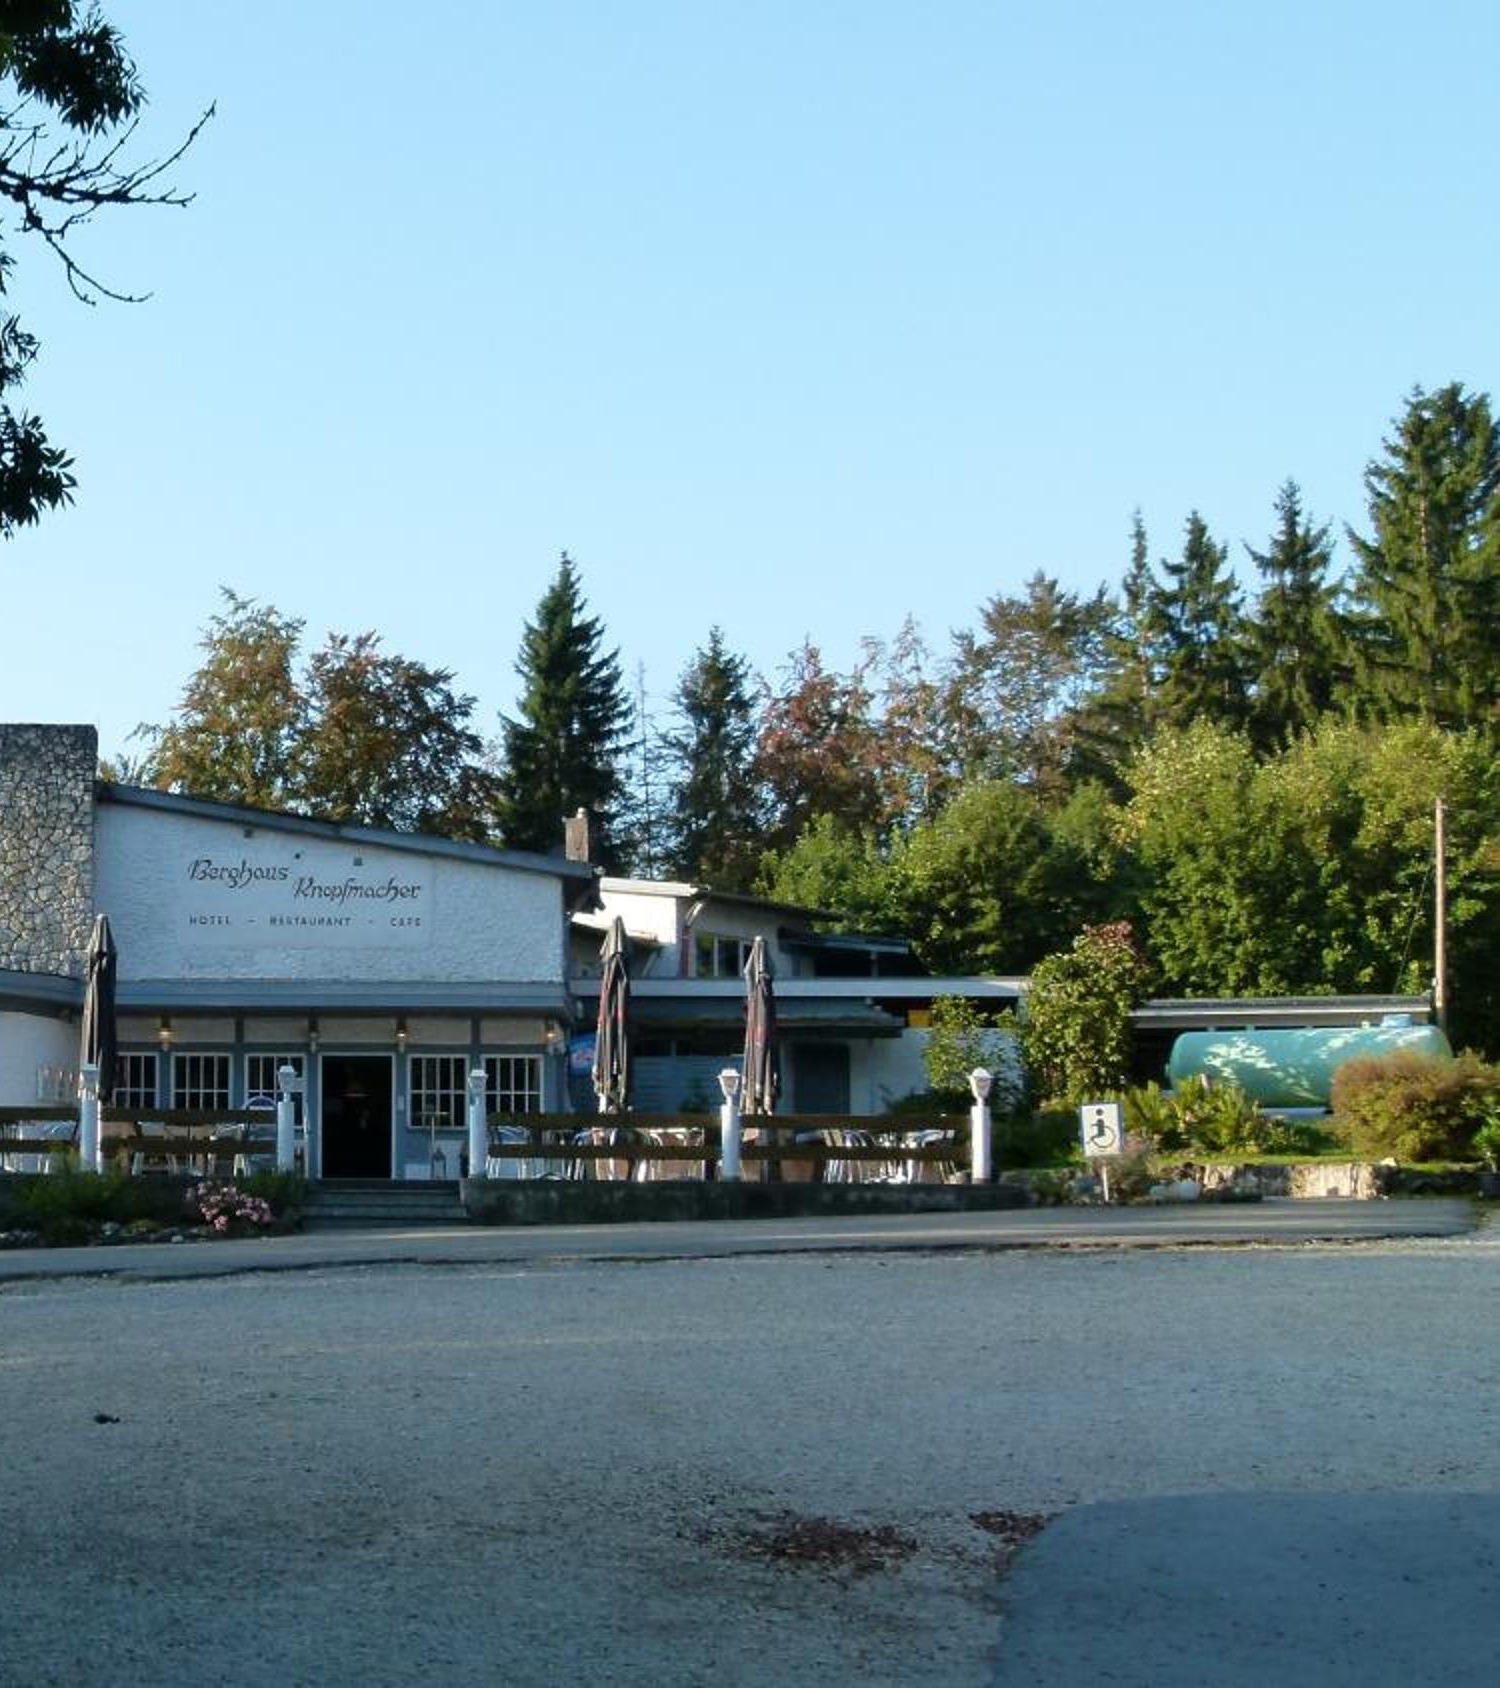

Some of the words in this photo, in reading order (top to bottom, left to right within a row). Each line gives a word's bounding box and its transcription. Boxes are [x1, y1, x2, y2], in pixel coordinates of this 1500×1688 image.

[187, 859, 289, 888] Berghaus
[294, 877, 421, 904] Knopfmacher
[189, 915, 230, 925] HOTEL
[269, 916, 352, 926] RESTAURANT
